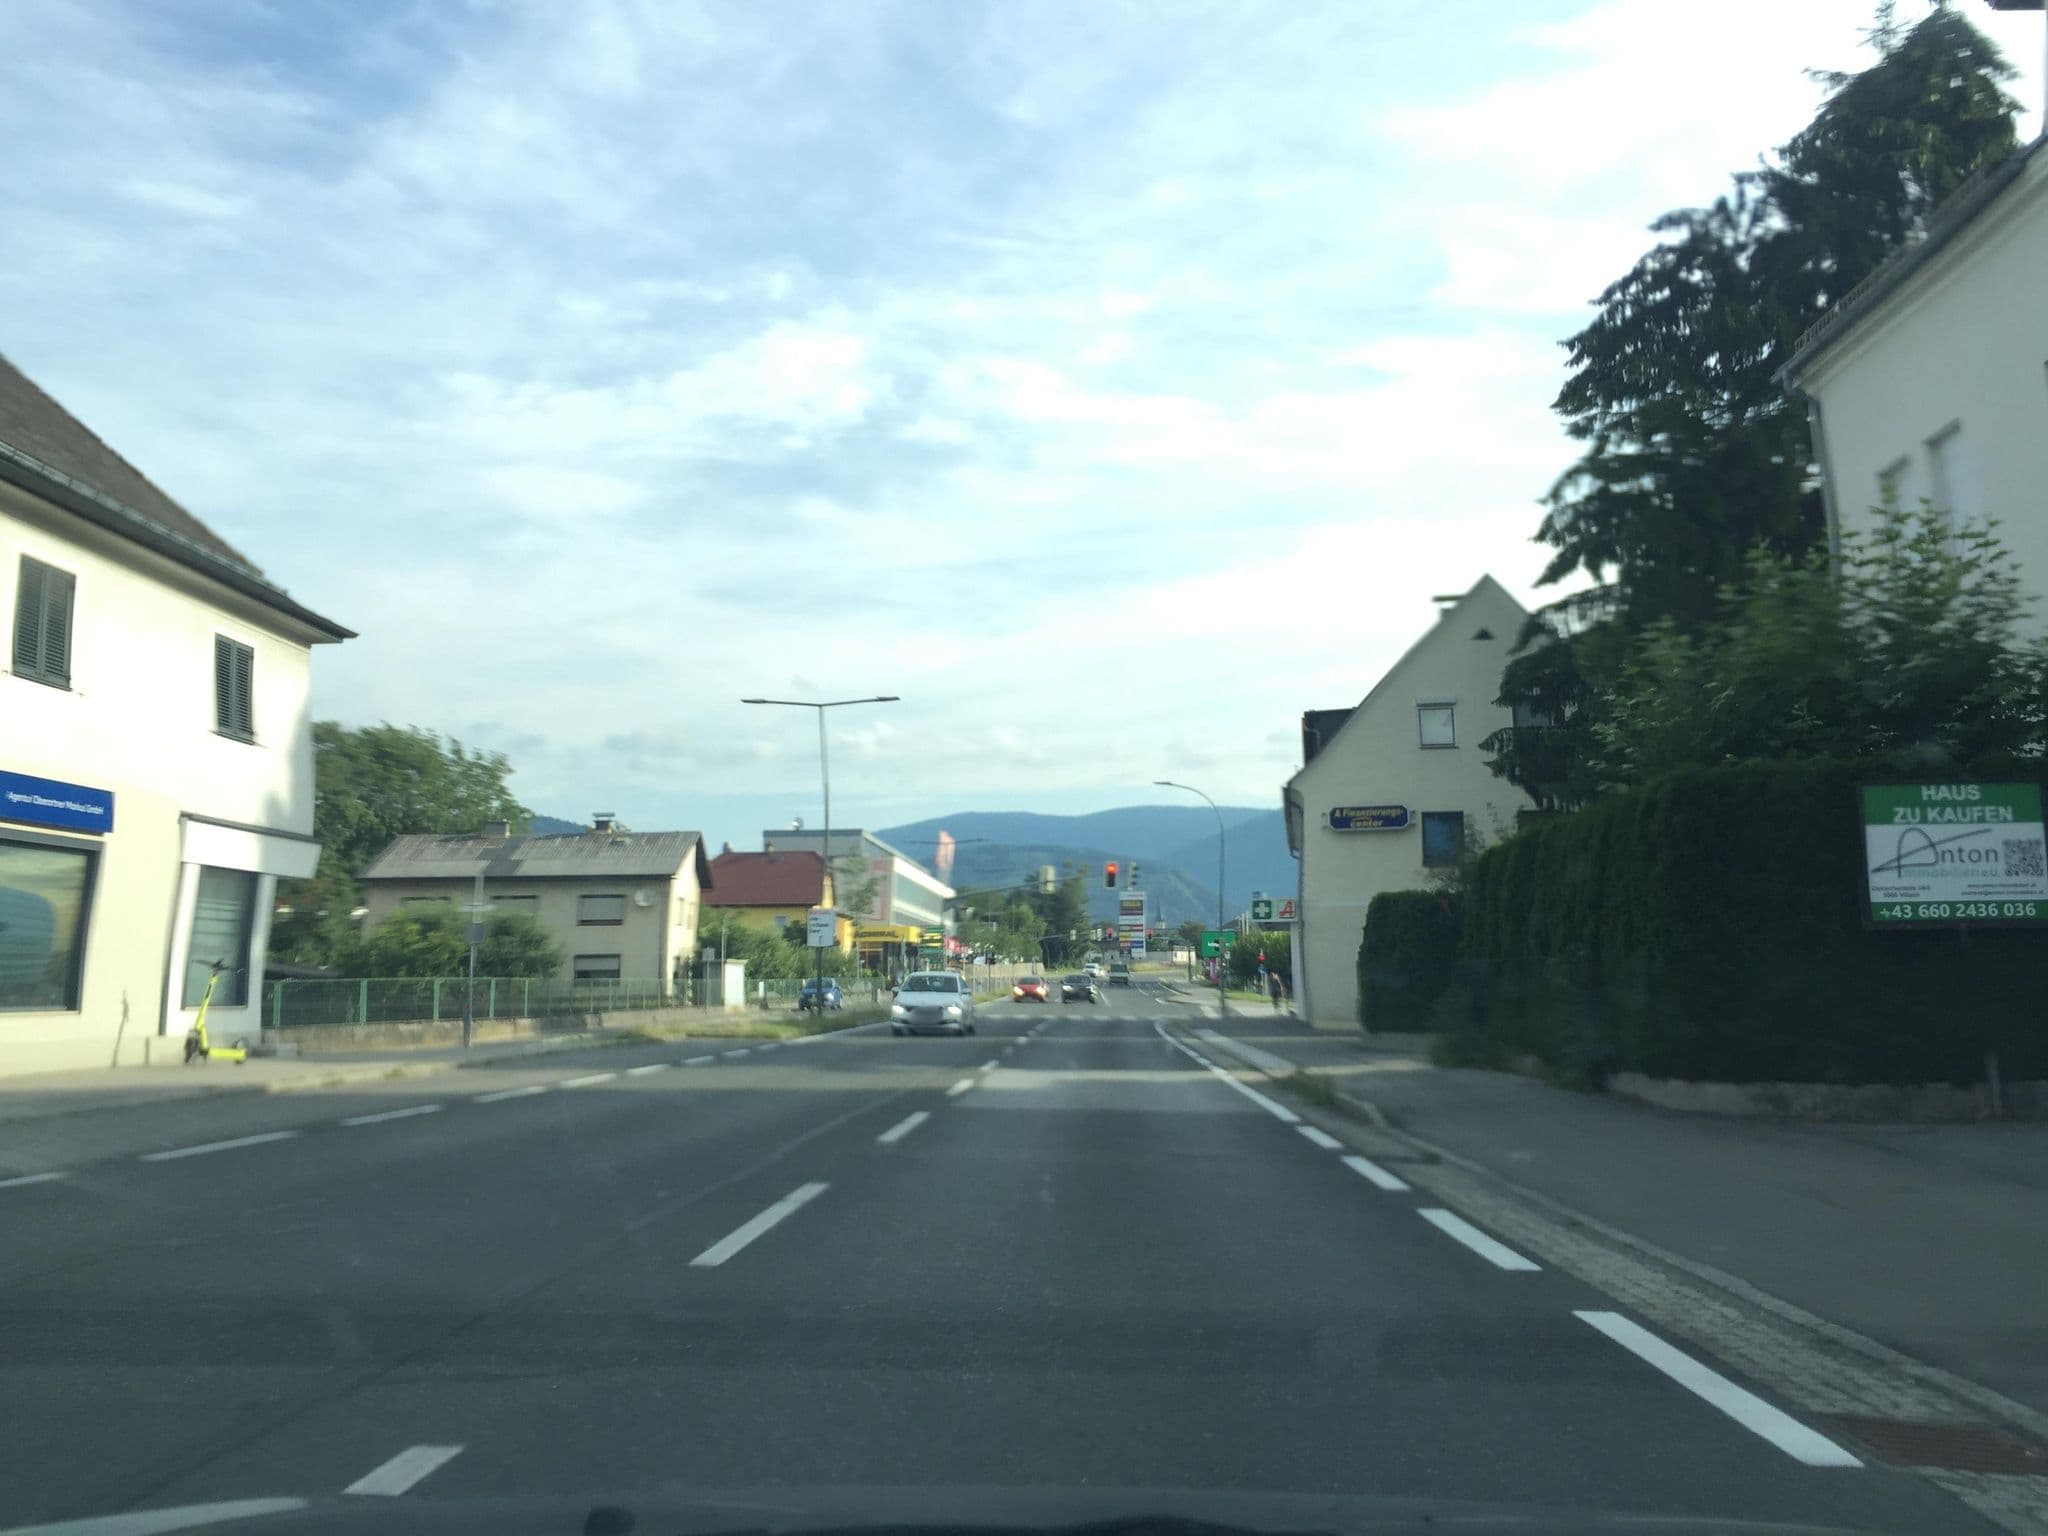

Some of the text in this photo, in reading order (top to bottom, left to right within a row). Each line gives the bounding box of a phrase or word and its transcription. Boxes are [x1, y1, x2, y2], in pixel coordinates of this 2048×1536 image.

[1921, 785, 1981, 801] HAUS
[1893, 806, 2014, 823] ZU KAUFEN
[1880, 903, 2036, 918] +43 660 2436 036
